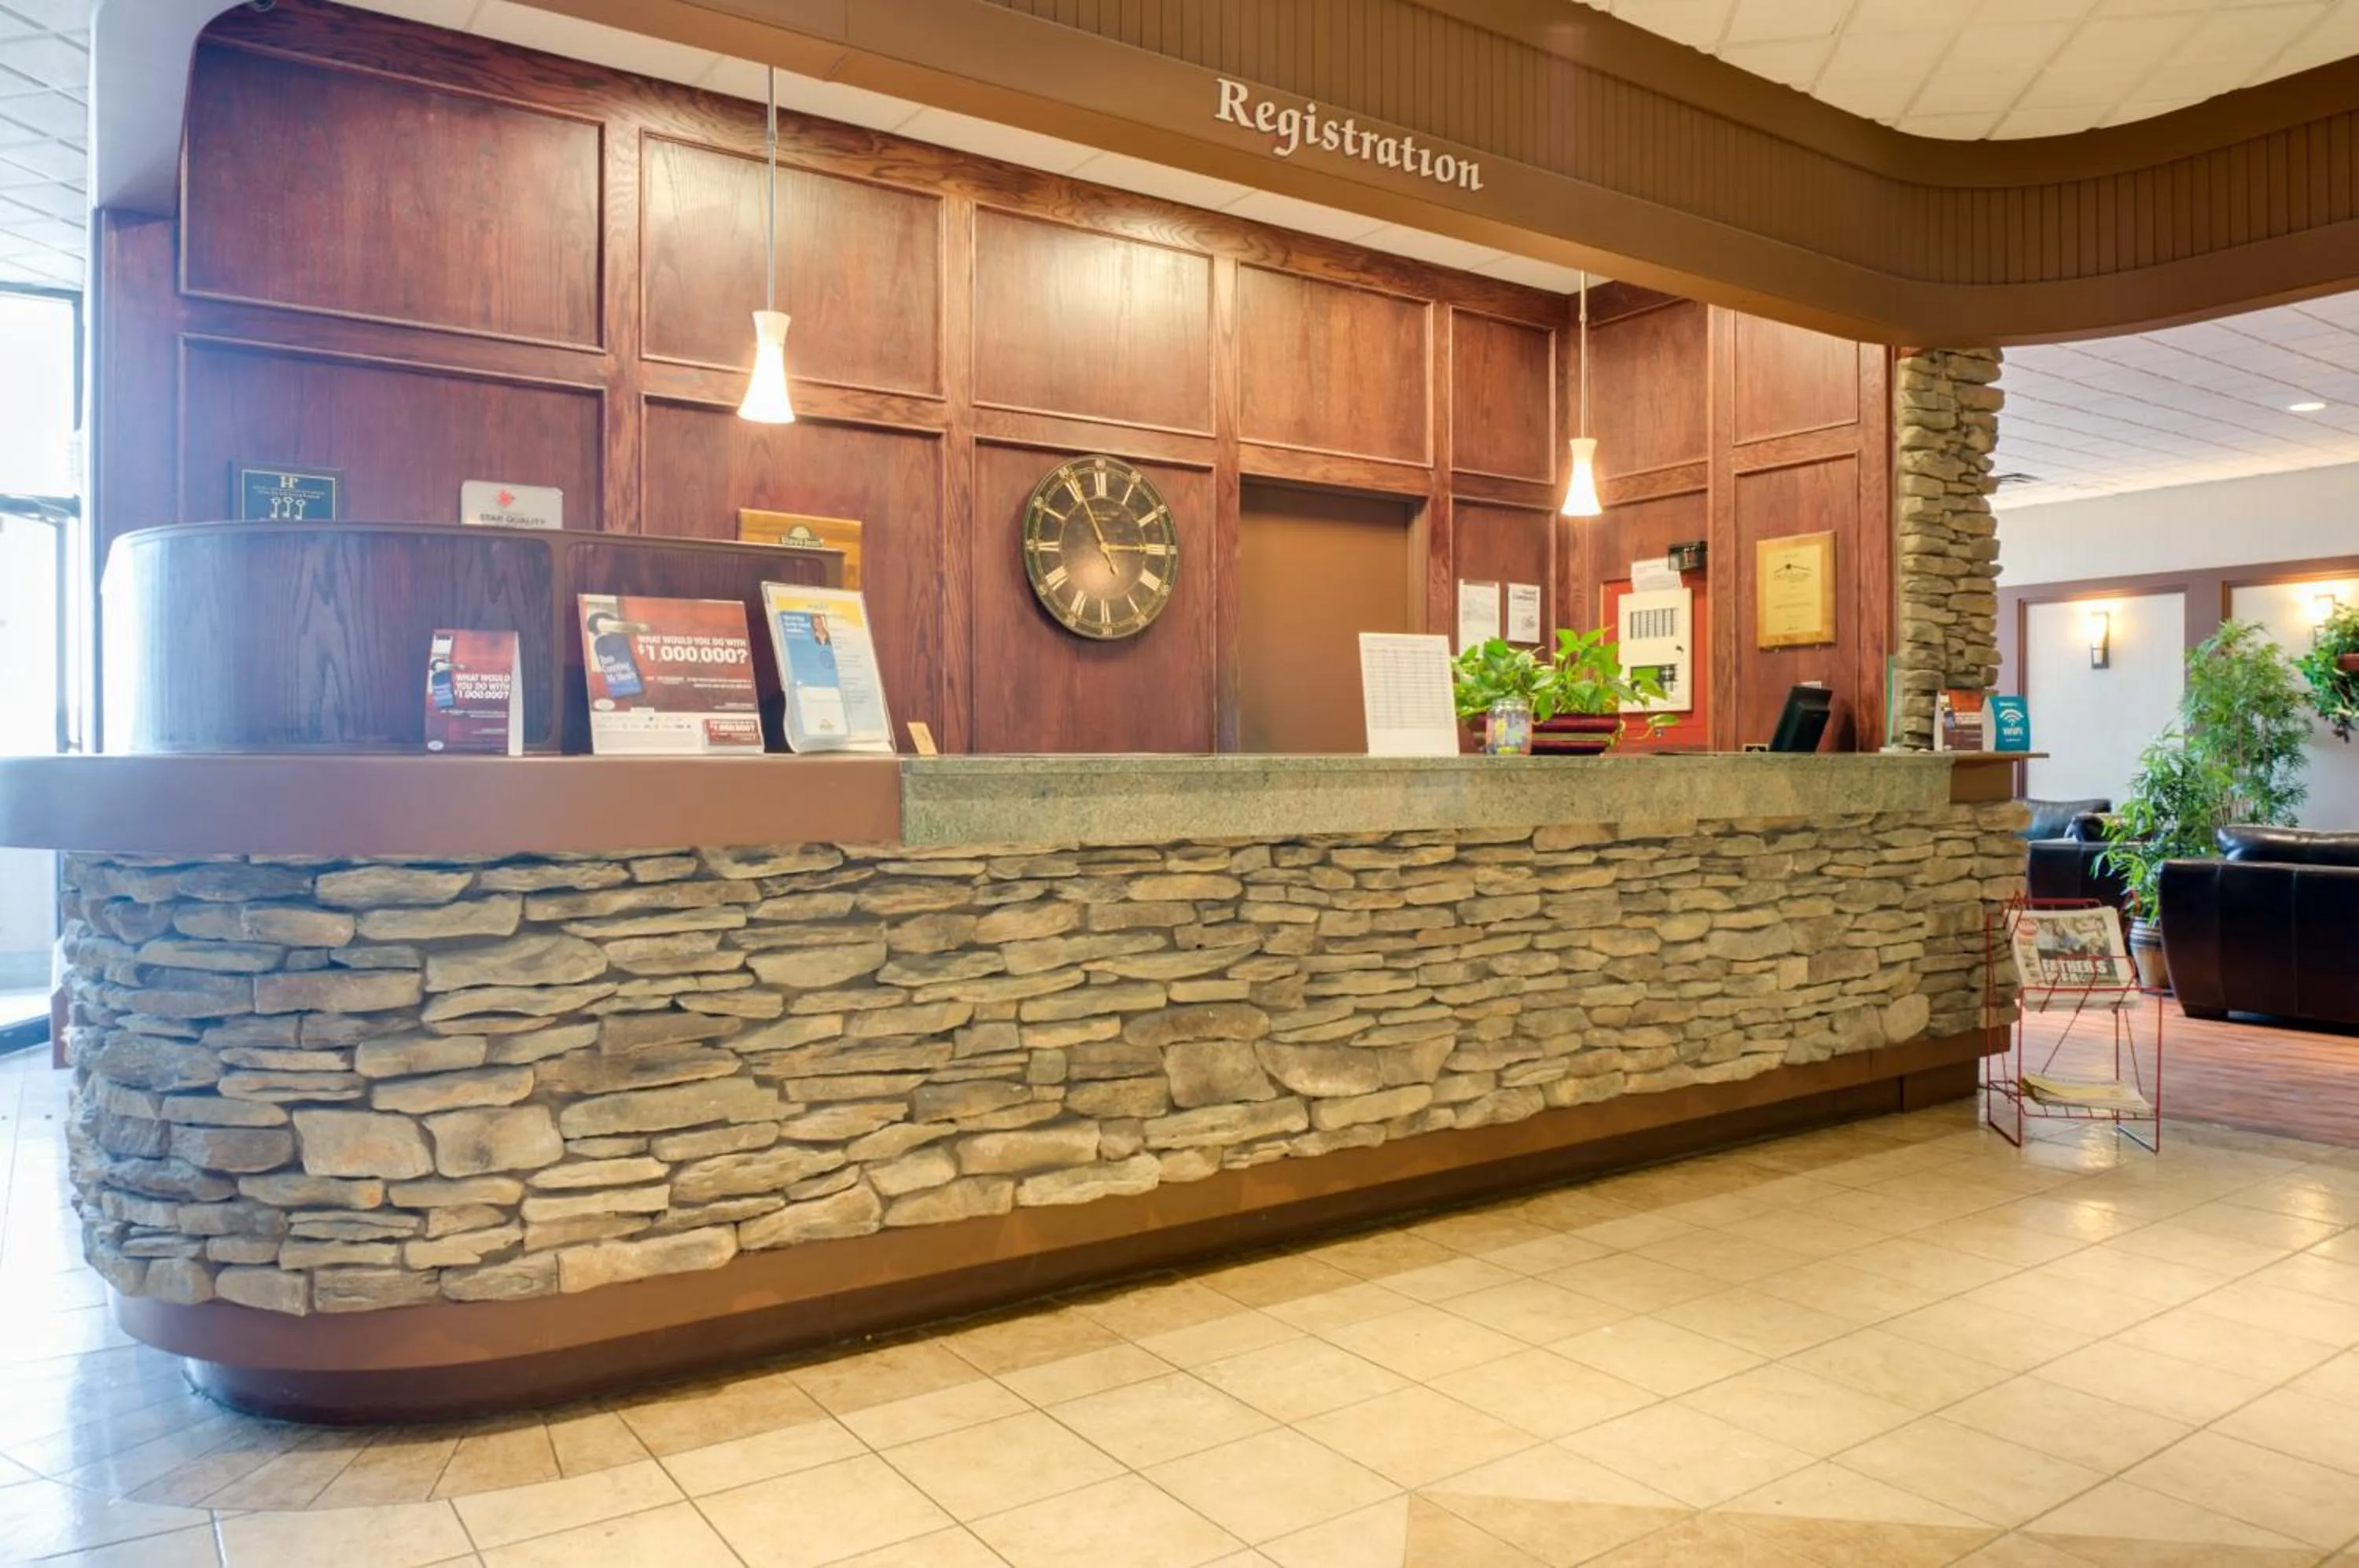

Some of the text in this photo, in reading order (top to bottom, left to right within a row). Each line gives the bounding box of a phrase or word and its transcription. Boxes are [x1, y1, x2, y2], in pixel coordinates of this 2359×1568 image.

[1214, 78, 1484, 191] Registration
[505, 514, 547, 526] QUALITY
[661, 635, 693, 646] WOULD
[693, 637, 710, 646] YOU
[711, 638, 724, 646] DO
[725, 638, 746, 647] WITH
[2042, 959, 2108, 974] FATHERS
